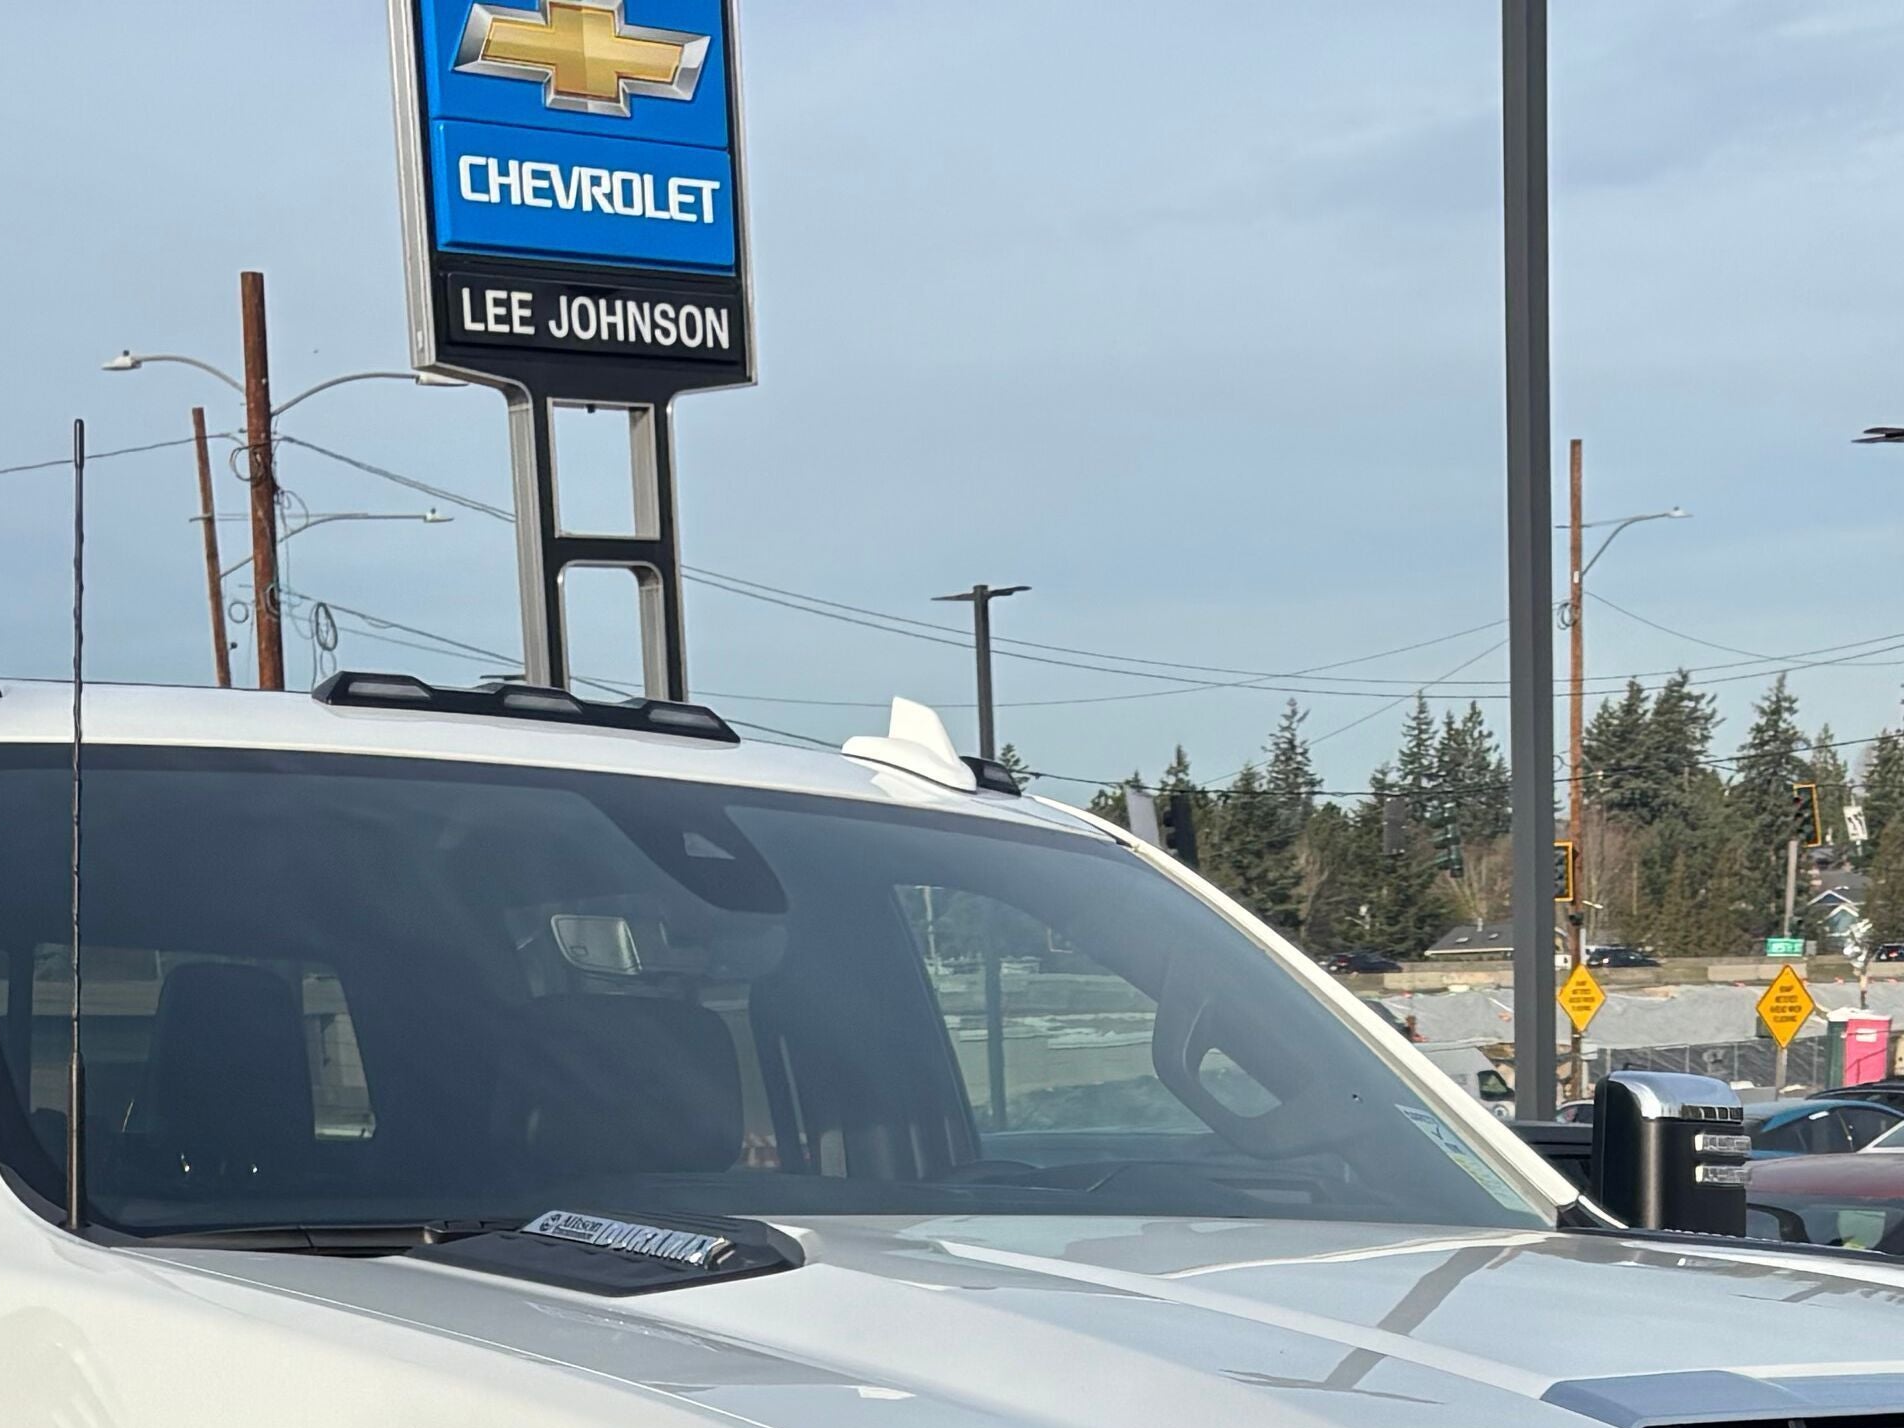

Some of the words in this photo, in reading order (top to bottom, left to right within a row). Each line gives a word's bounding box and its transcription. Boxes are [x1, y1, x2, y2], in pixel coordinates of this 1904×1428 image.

[459, 155, 720, 223] CHEVROLET
[461, 287, 535, 335] LEE
[548, 295, 729, 350] JOHNSON
